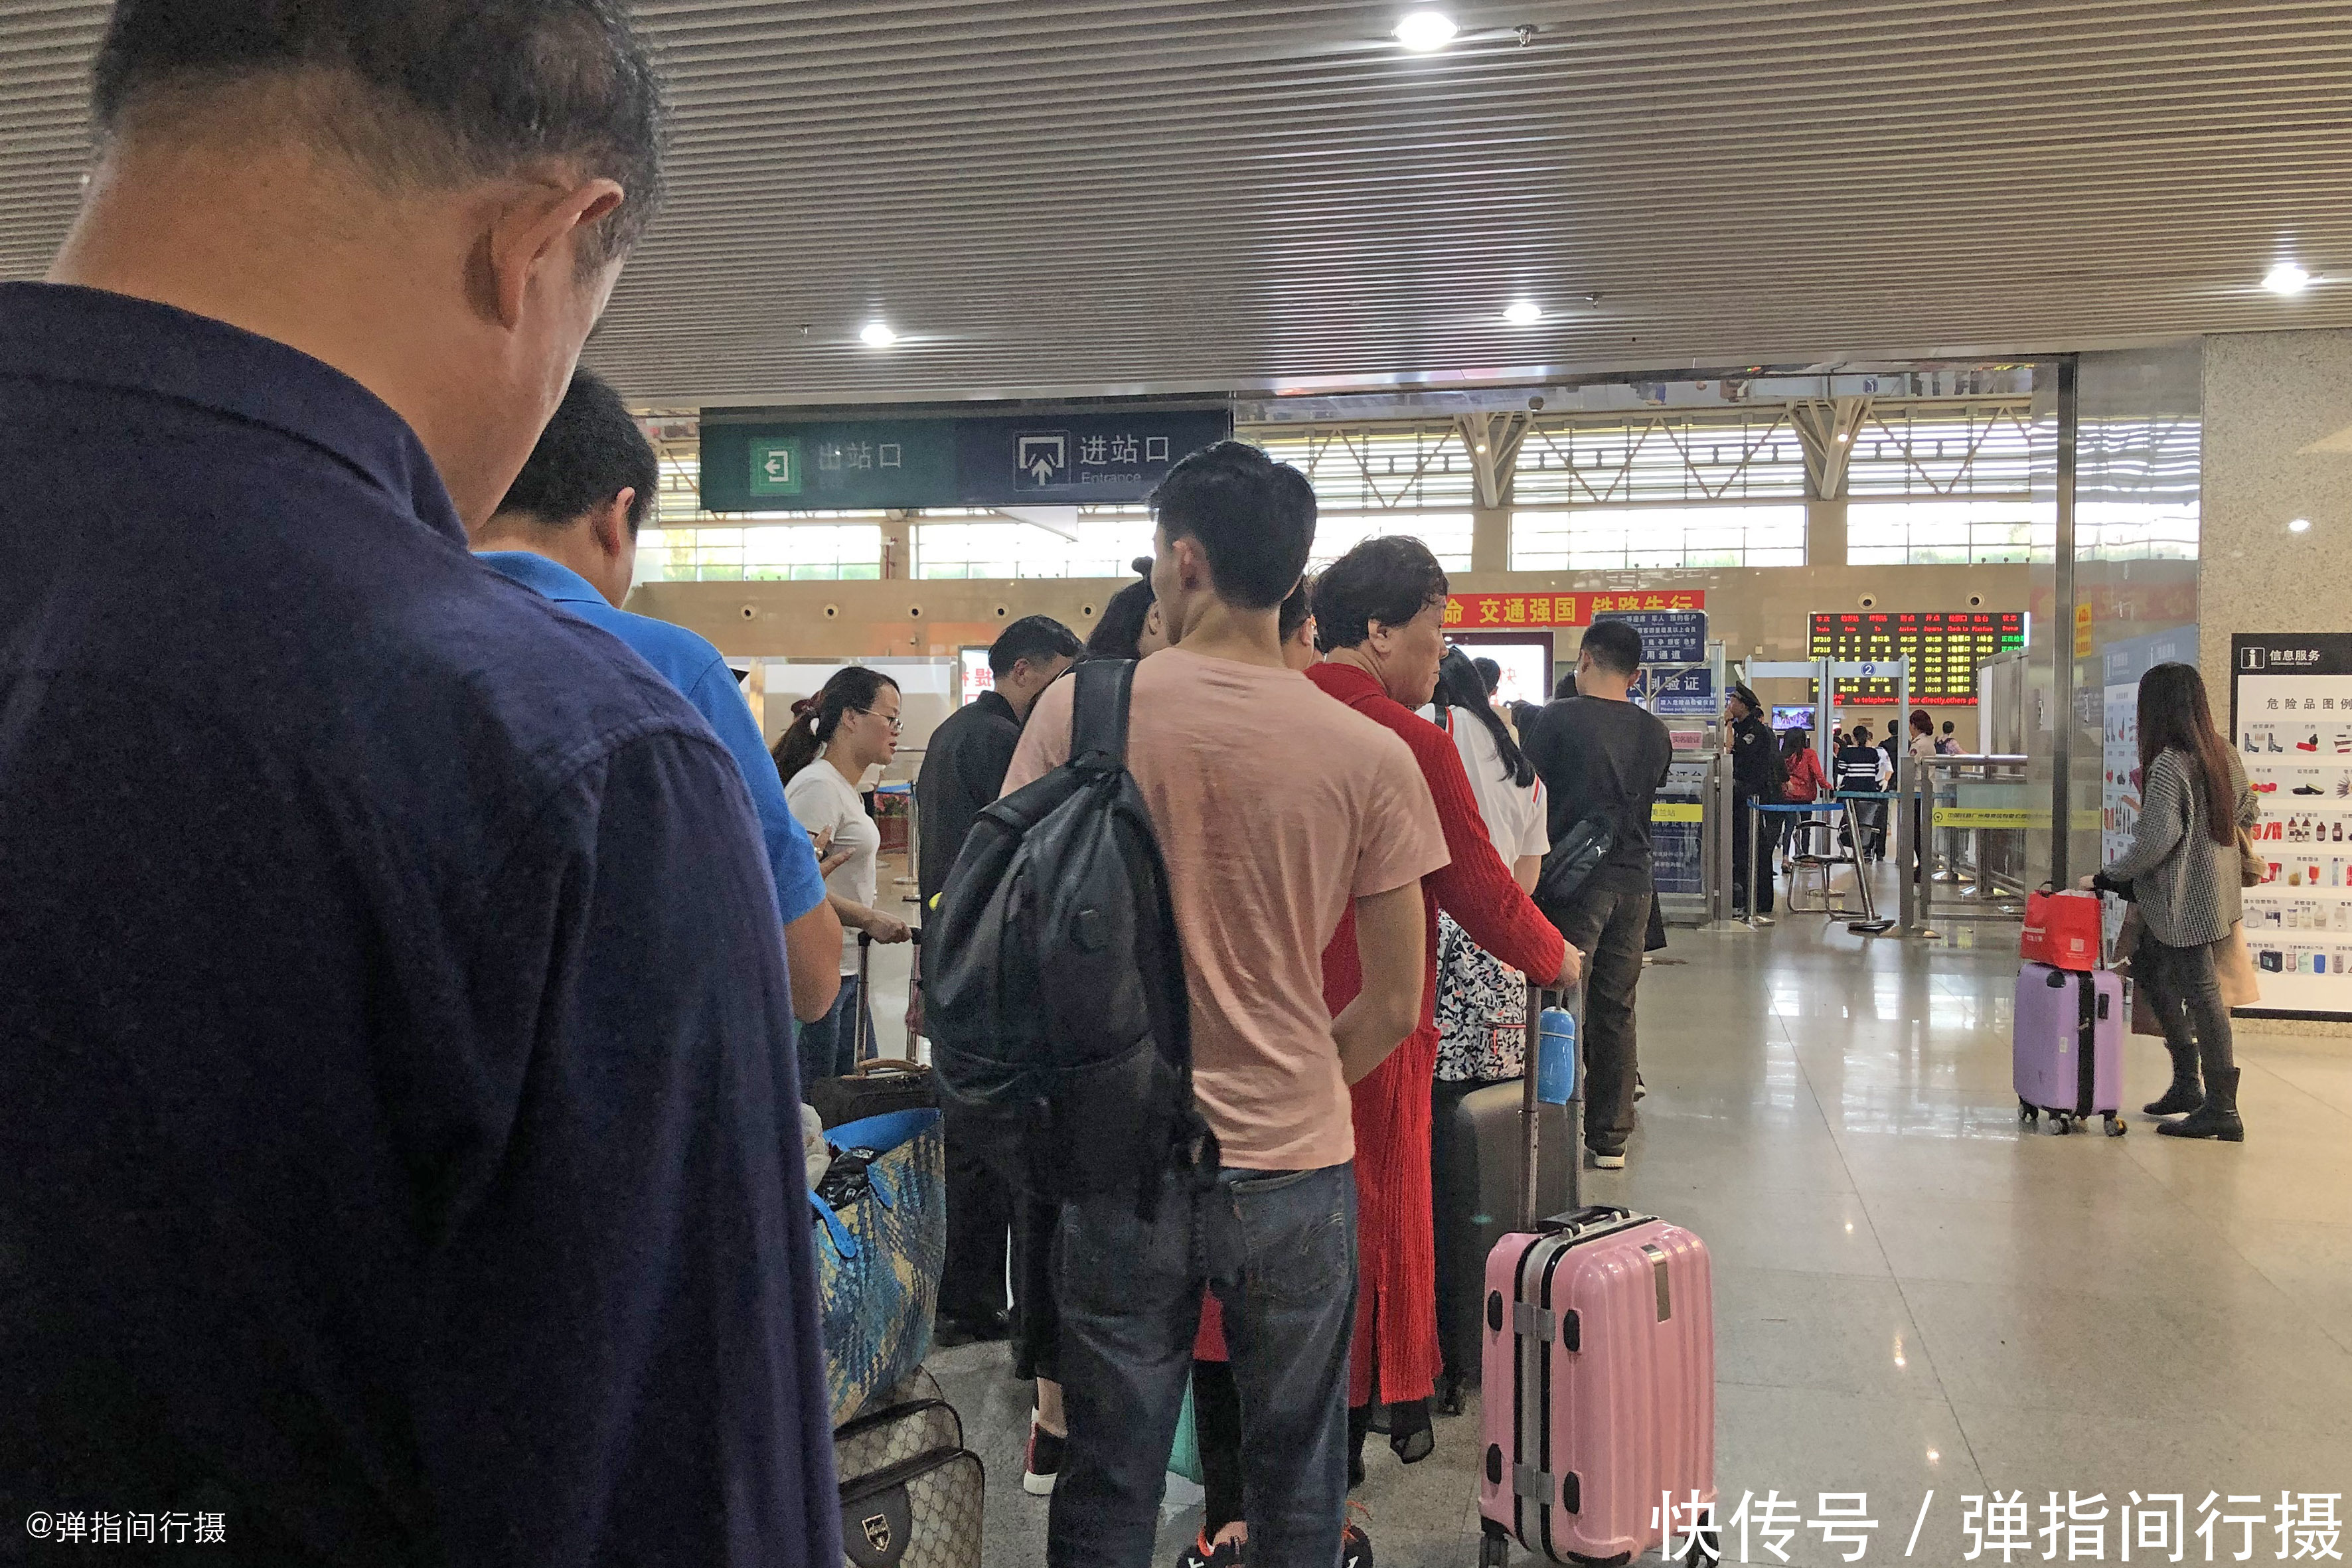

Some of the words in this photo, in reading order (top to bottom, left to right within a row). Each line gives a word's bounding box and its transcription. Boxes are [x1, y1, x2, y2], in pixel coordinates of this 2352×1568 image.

[1079, 434, 1168, 465] 进站口
[819, 441, 901, 470] 出站口
[1081, 472, 1141, 484] Entrance
[1444, 598, 1464, 623] 命
[1479, 597, 1576, 623] 交通强国
[1640, 650, 1680, 660] 用通道
[2270, 650, 2320, 661] 信息服务
[1865, 665, 1872, 674] 2
[2267, 698, 2352, 709] 危险品图例
